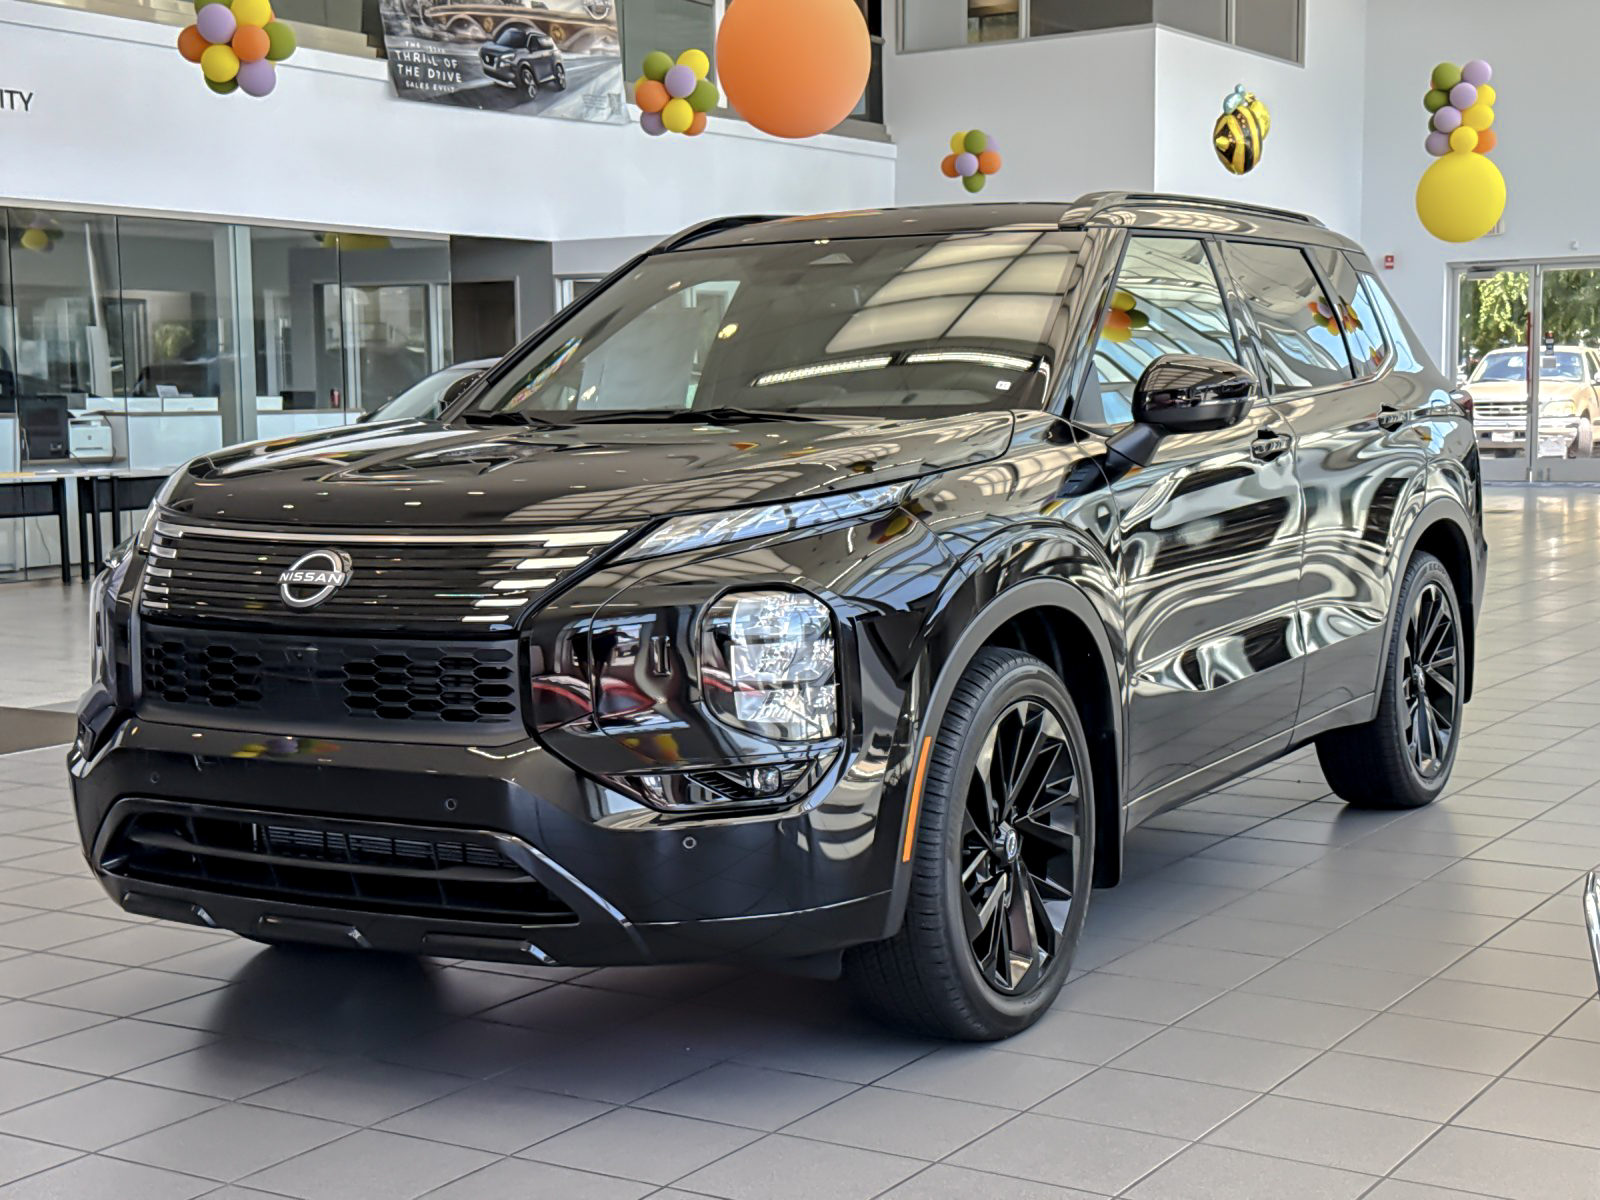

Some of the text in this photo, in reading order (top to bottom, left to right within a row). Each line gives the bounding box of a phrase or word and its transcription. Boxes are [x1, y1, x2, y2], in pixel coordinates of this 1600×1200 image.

[394, 49, 438, 67] THRILL
[443, 57, 458, 69] OF
[396, 63, 420, 78] THE
[405, 80, 430, 90] SALES
[0, 88, 34, 112] ITY
[279, 571, 343, 584] NISSAN
